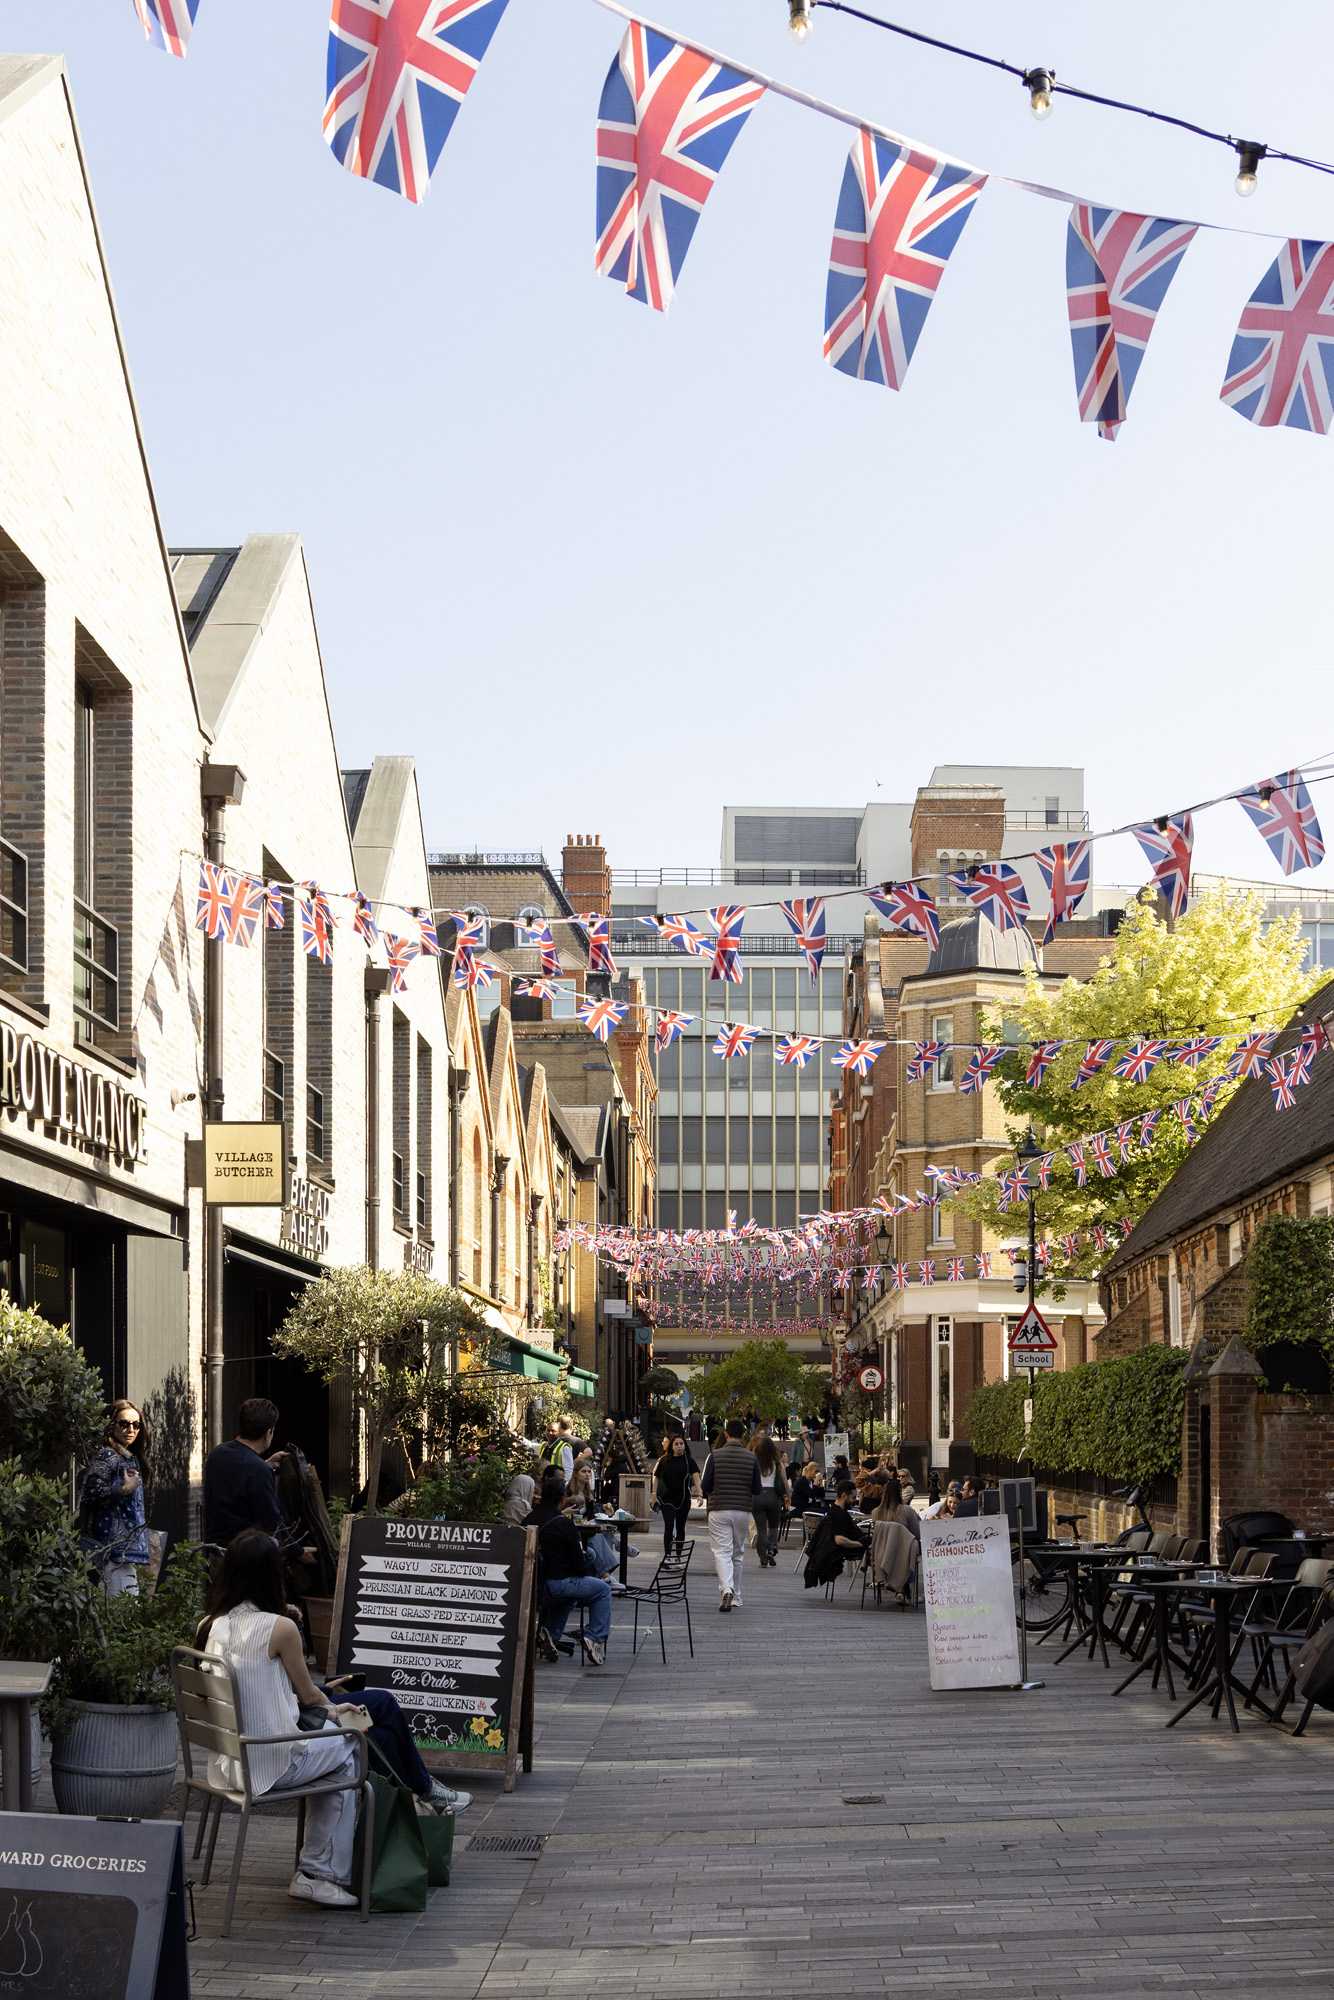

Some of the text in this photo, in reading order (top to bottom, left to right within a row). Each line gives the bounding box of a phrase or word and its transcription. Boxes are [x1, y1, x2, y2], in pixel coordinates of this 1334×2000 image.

[216, 1153, 273, 1162] VILLAGE
[215, 1167, 273, 1177] BUTCHER
[291, 1174, 329, 1219] BREAD
[291, 1210, 329, 1252] AHEAD
[411, 1243, 433, 1273] BREAD
[1018, 1355, 1049, 1363] School
[386, 1523, 492, 1544] PROVENANCE
[930, 1537, 946, 1549] The
[965, 1530, 983, 1542] The
[984, 1527, 1000, 1540] Sea
[927, 1544, 986, 1558] FISHMONGERS
[384, 1560, 487, 1576] WAGYU SELECTION
[934, 1567, 961, 1579] TURBOT
[365, 1582, 497, 1601] PRUSSIAN BLACK DIAMOND
[938, 1595, 975, 1606] LEMON SOLE
[363, 1605, 499, 1624] BRITISH GRASS-FED EX-DAIRY
[933, 1623, 957, 1635] Oysters
[391, 1631, 467, 1646] GALICIAN BEEF
[393, 1655, 462, 1669] IBERICO PORK
[967, 1656, 973, 1664] of
[391, 1669, 460, 1690] Pre-Order
[391, 1692, 476, 1711] SSERIE CHICKENS
[50, 1854, 147, 1873] GROCERIES
